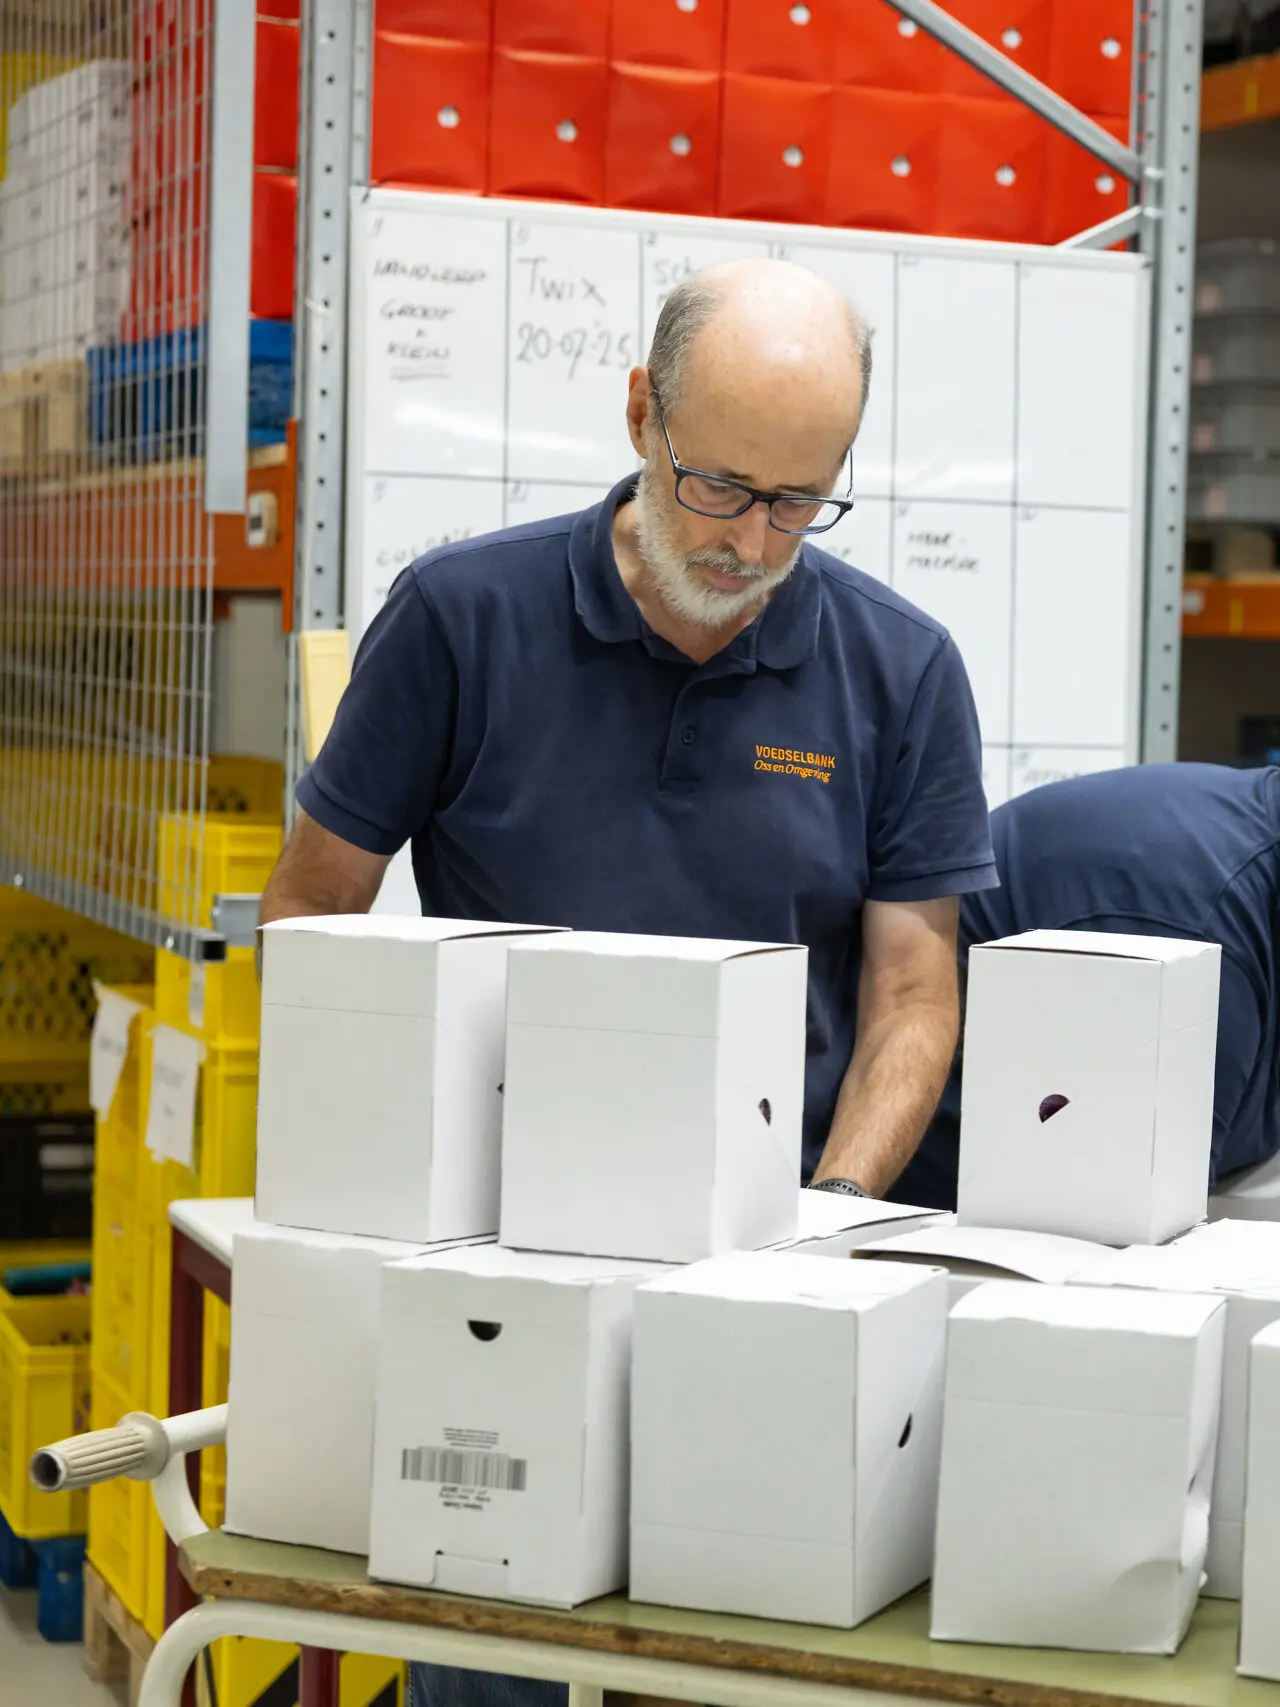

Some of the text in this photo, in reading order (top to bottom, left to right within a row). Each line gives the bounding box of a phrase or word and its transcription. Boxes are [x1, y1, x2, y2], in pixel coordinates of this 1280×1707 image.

[516, 254, 607, 308] Twix
[753, 760, 772, 771] Oss
[774, 764, 785, 773] en
[755, 745, 836, 769] VOEDSELBANK
